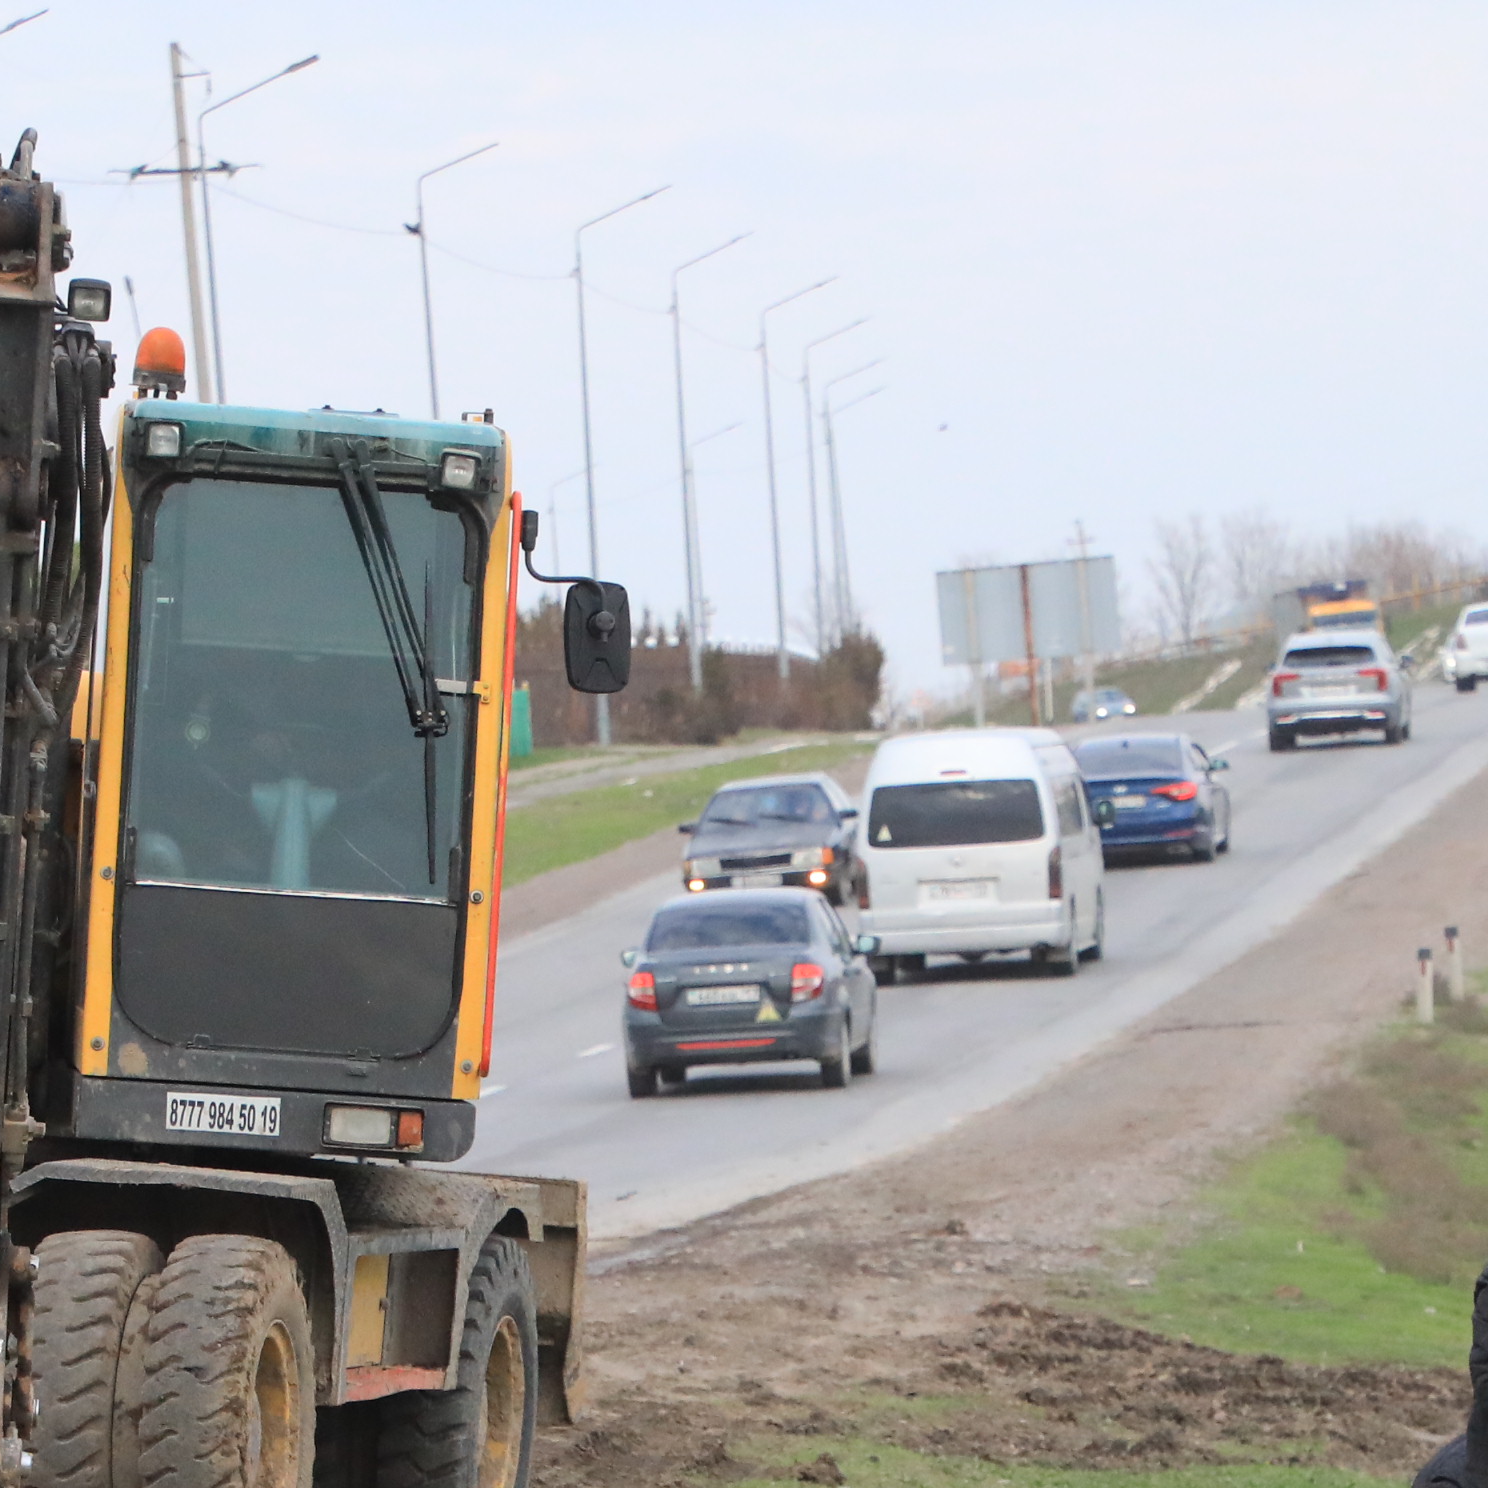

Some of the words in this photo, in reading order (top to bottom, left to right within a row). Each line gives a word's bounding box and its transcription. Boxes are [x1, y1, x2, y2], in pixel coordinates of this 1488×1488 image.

[169, 1098, 205, 1128] 8777
[208, 1101, 234, 1130] 984
[238, 1103, 256, 1132] 50
[261, 1105, 277, 1133] 19
